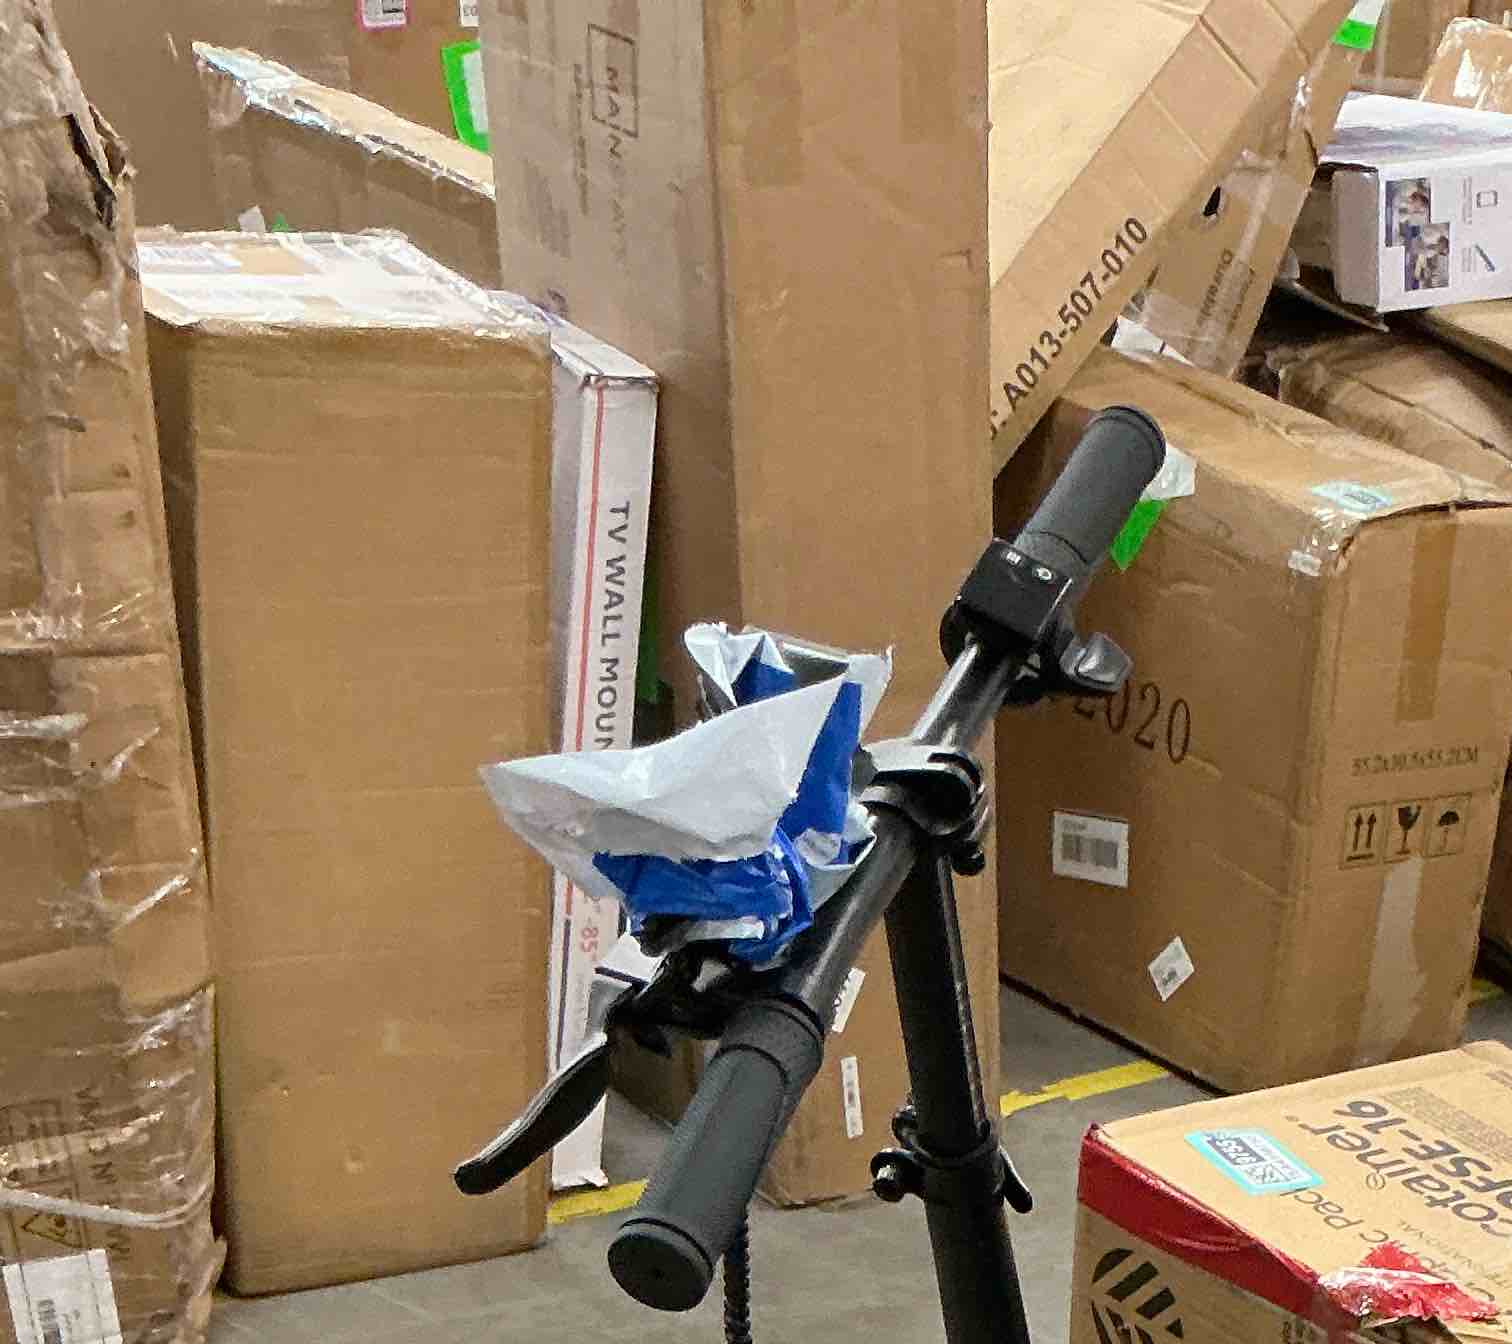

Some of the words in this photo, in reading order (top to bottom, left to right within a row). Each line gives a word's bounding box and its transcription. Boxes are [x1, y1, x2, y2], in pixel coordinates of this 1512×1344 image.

[1003, 216, 1148, 411] A013-507-010
[608, 501, 631, 544] TV
[601, 554, 627, 647] WALL
